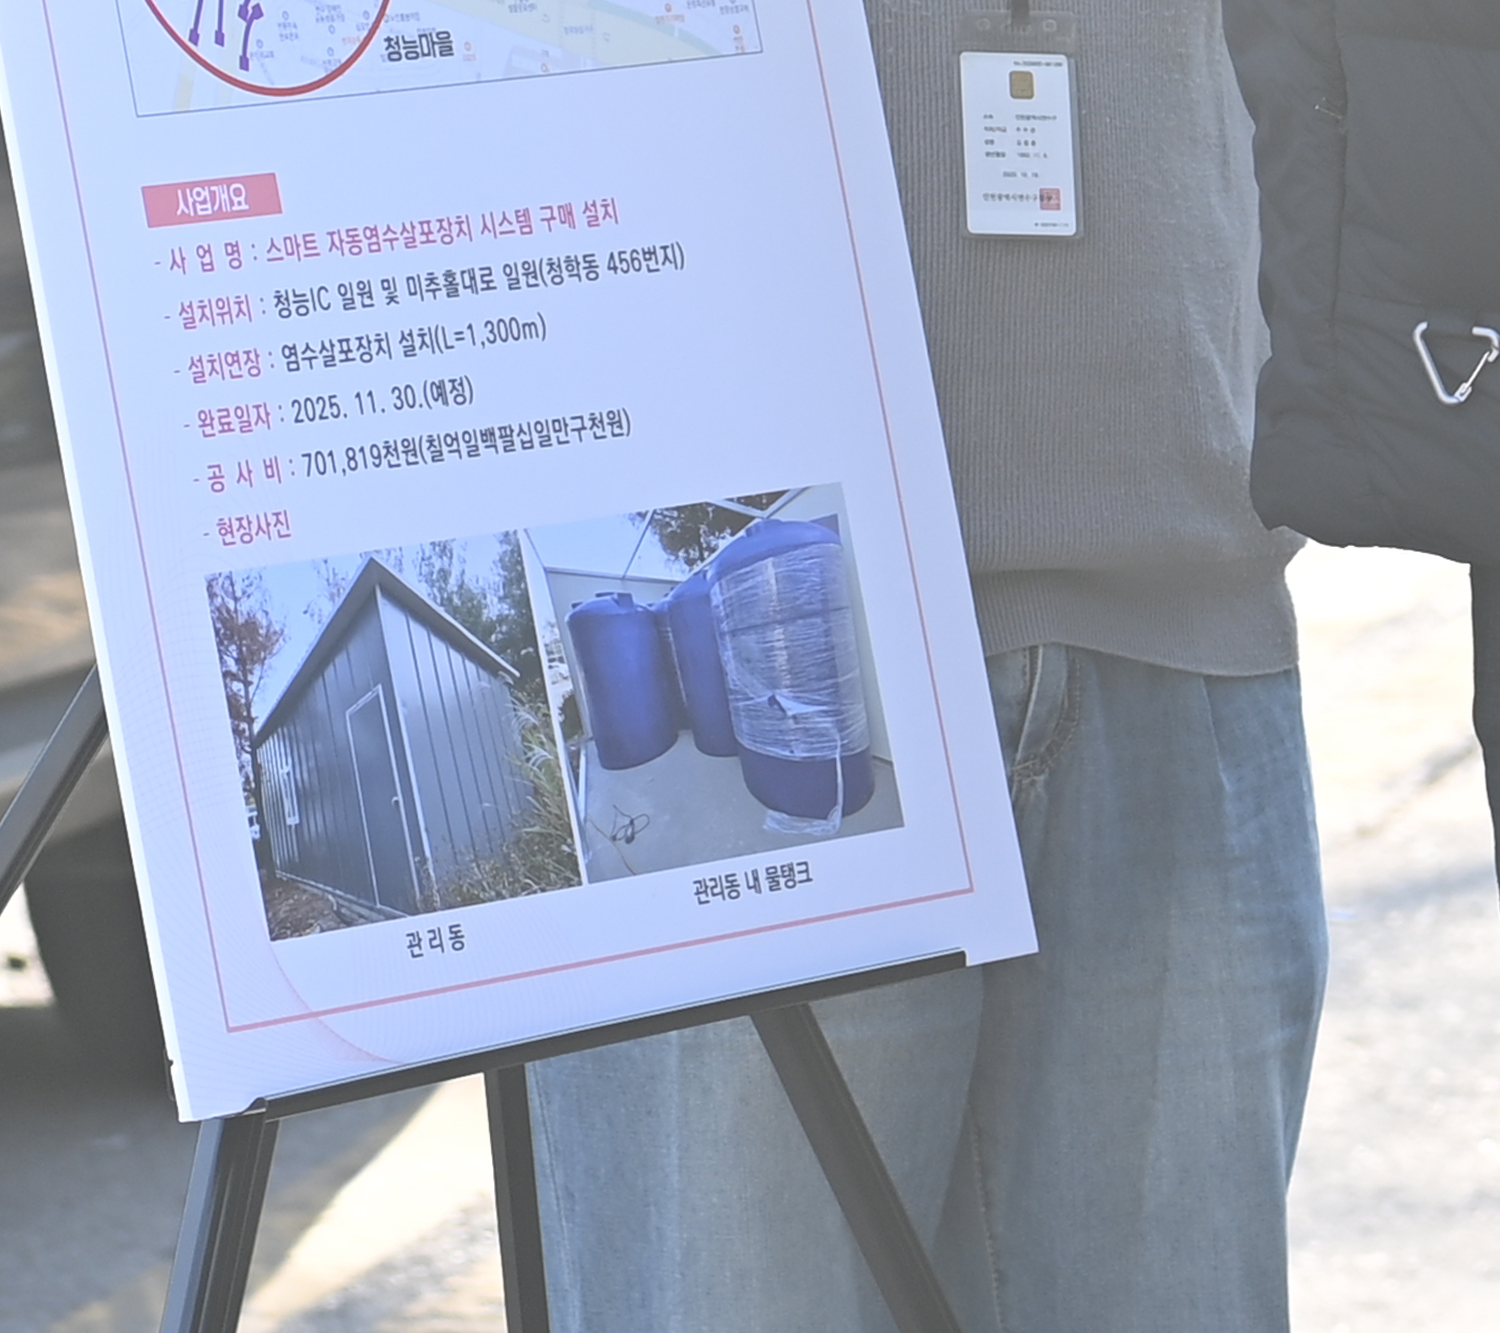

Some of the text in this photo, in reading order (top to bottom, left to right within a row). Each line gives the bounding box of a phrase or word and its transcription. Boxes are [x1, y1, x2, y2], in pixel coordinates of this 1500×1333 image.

[383, 31, 455, 62] 청능마을
[176, 183, 249, 216] 사업개요
[266, 232, 321, 262] 스마트
[326, 214, 473, 257] 자동염수살포장치
[480, 207, 533, 239] 시스템
[539, 202, 576, 232] 구매
[582, 197, 619, 227] 설치
[179, 294, 253, 330] 설치위치
[274, 286, 331, 319] 청능IC
[337, 280, 375, 311] 일원
[381, 277, 400, 306] 및
[406, 266, 497, 302] 미추홀대로
[502, 252, 600, 291] 일원(청학동
[607, 241, 685, 275] 456번지)
[188, 348, 261, 384] 설치연장
[281, 332, 393, 372] 염수살포장치
[197, 402, 271, 438] 완료일자
[291, 395, 348, 424] 2025.
[354, 390, 386, 415] 11.
[216, 510, 292, 546] 현장사진
[692, 861, 814, 906] 관리동 내 물탱크
